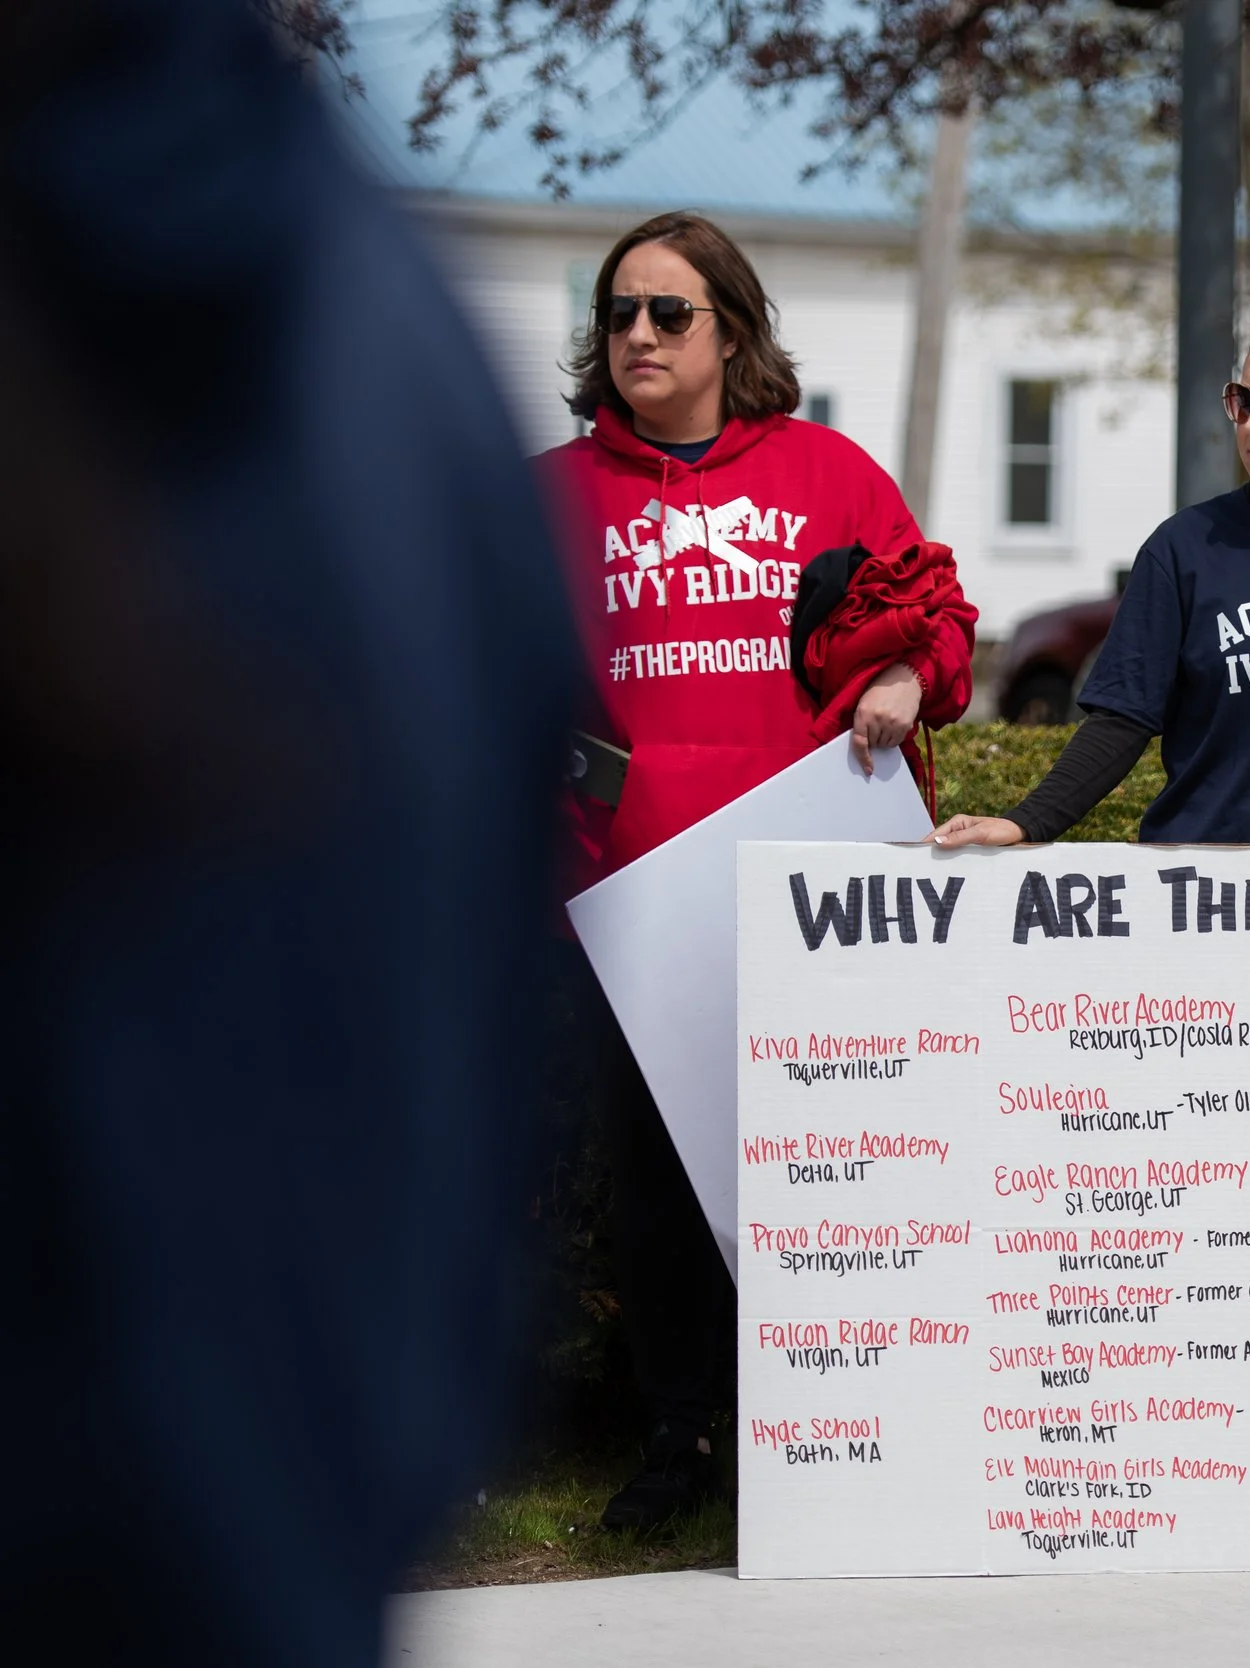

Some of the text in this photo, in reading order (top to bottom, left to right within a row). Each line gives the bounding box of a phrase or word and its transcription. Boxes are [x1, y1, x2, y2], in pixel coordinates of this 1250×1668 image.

[604, 567, 674, 614] IVY
[789, 871, 966, 952] WHY
[1012, 870, 1130, 945] ARE
[1007, 995, 1066, 1034] Bear
[1074, 993, 1130, 1025] River
[1135, 992, 1236, 1027] Academy
[749, 1028, 980, 1063] Kiva Adventure Ranch
[743, 1131, 949, 1165] White River Academy
[844, 1160, 875, 1182] UT
[995, 1159, 1249, 1203] Eagle Ranch Academy
[1065, 1191, 1091, 1217] St.
[750, 1219, 971, 1252] Provo Canyon School
[994, 1231, 1079, 1255] Liahona
[1090, 1229, 1184, 1253] Academy
[892, 1248, 923, 1269] UT
[988, 1291, 1040, 1313] Three
[1049, 1283, 1109, 1307] Points
[1187, 1285, 1243, 1303] Former
[759, 1317, 970, 1348] Falcon Ridge Ranch
[855, 1346, 887, 1367] UT
[991, 1345, 1055, 1373] Sunset
[1061, 1343, 1095, 1372] Bay
[1187, 1341, 1238, 1360] Former
[1040, 1367, 1090, 1389] Mexico
[983, 1405, 1082, 1433] Clearview
[1090, 1399, 1139, 1423] Girls
[751, 1416, 881, 1449] Hyde School
[1091, 1423, 1118, 1444] MT
[848, 1441, 882, 1463] MA
[986, 1455, 1247, 1484] Elk Mountain Girls Academy
[1025, 1478, 1080, 1498] Clark's
[1125, 1482, 1152, 1499] ID
[987, 1507, 1177, 1537] Lava Height Academy
